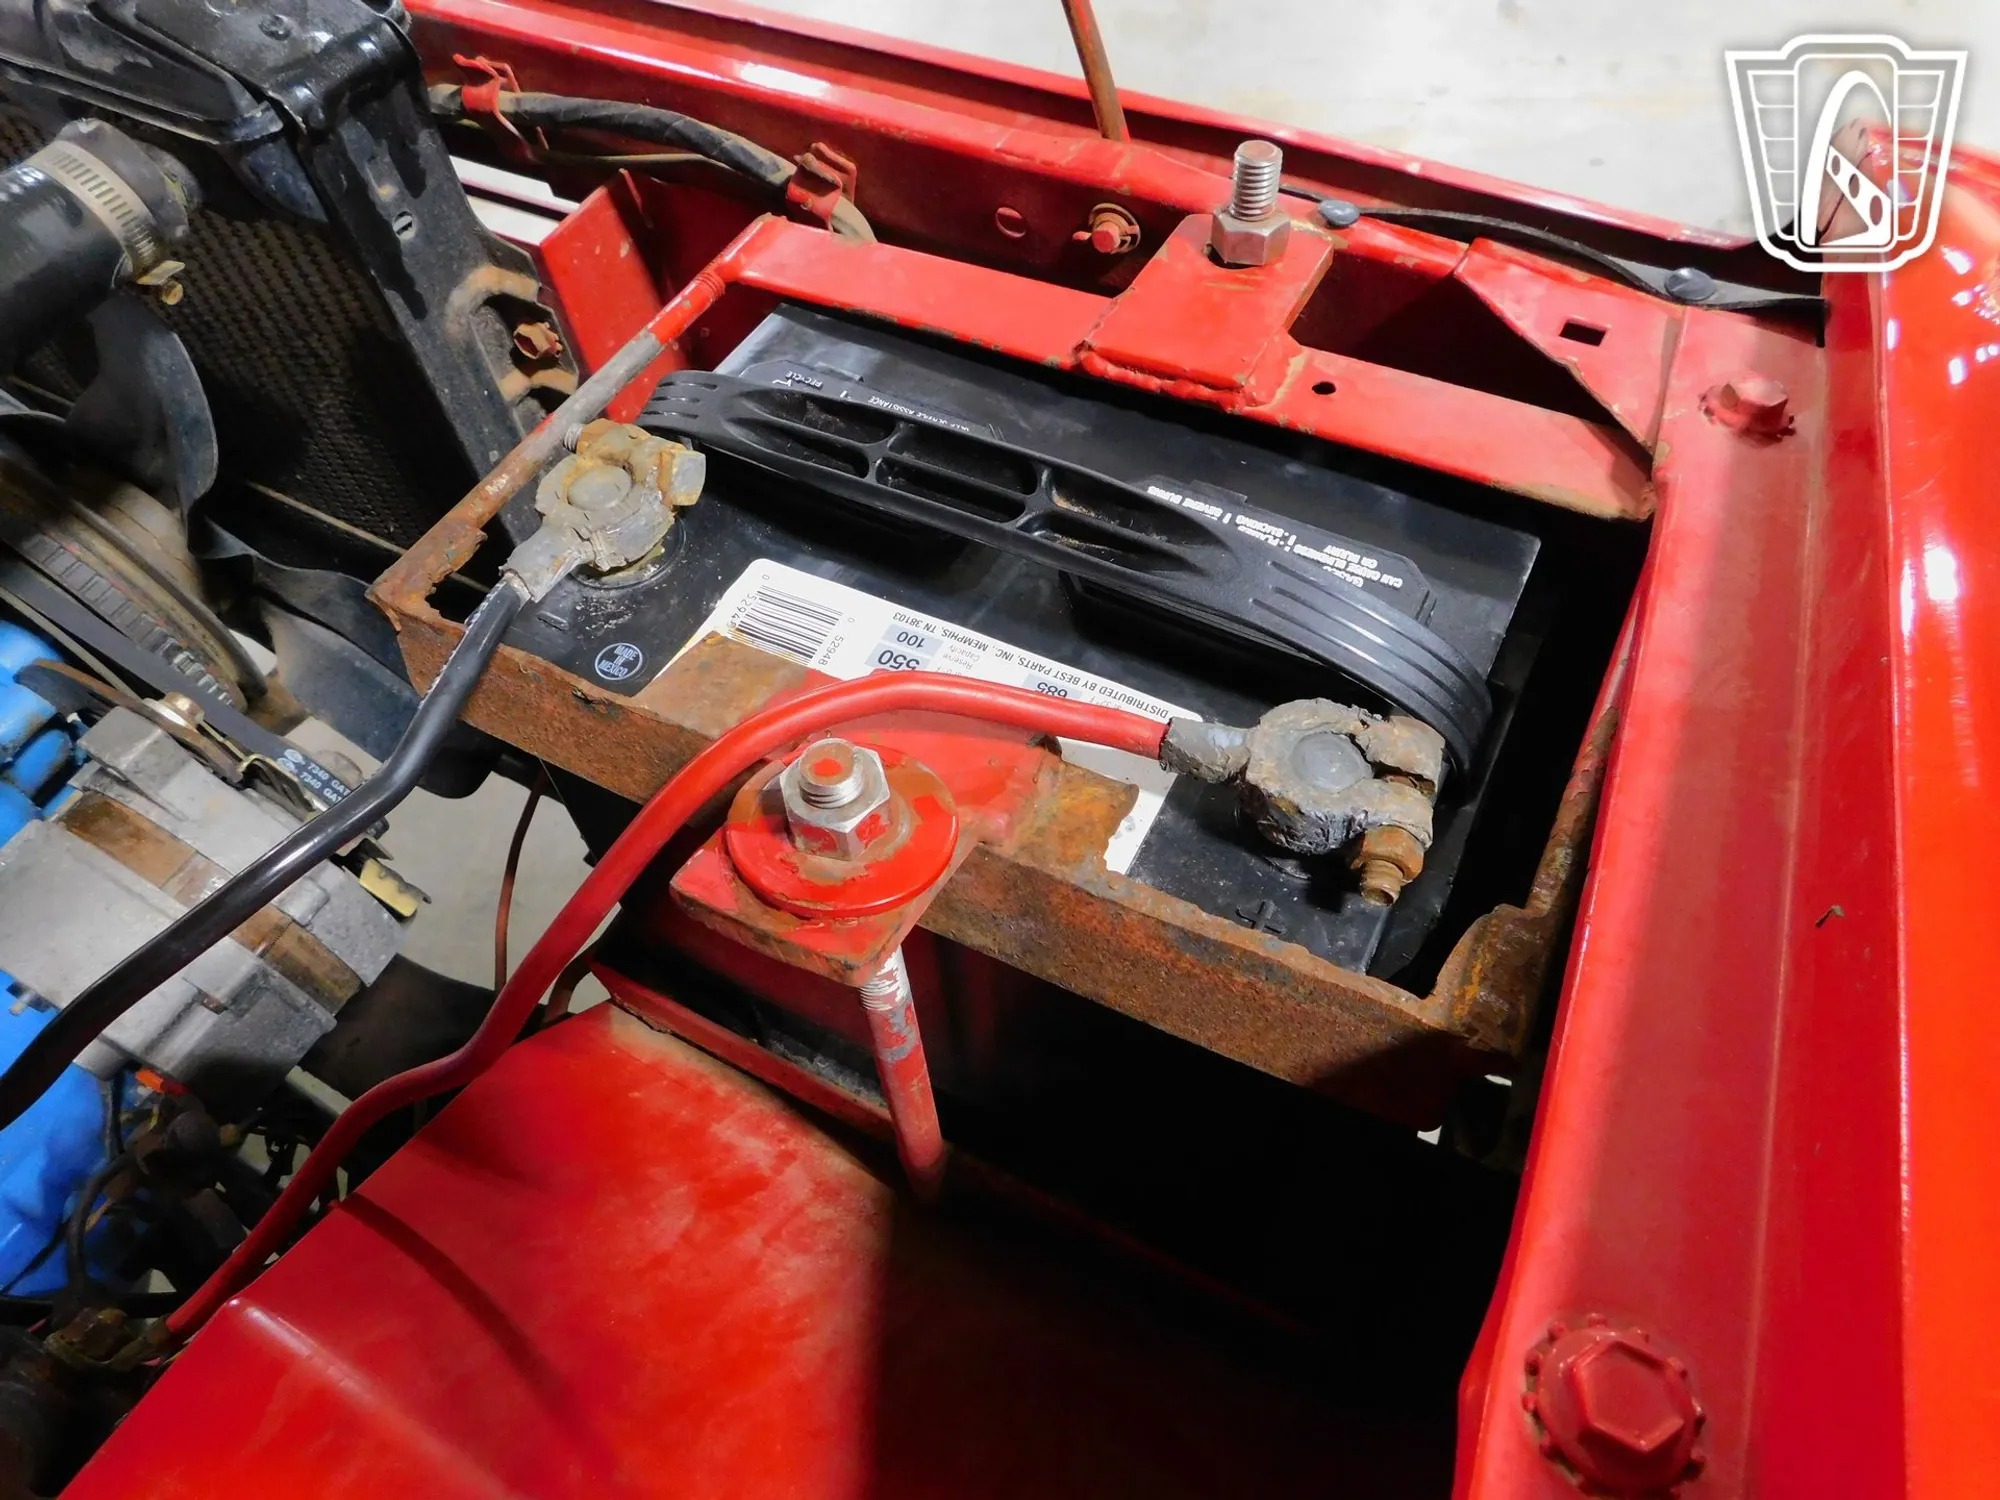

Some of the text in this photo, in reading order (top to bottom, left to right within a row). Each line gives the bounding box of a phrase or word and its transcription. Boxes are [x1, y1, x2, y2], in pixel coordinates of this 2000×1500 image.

[786, 371, 823, 388] RECYCLE
[1147, 486, 1182, 505] BURNS
[1323, 545, 1378, 569] OR INJURY
[1346, 562, 1381, 581] CAUSE
[1380, 574, 1403, 588] CAN
[896, 631, 925, 648] 100
[613, 645, 638, 661] MADE
[818, 635, 844, 666] 52948
[949, 645, 981, 663] Capacity
[598, 659, 629, 677] MEXICO
[613, 655, 626, 666] IN
[878, 649, 920, 671] 550
[893, 611, 1169, 719] DISTRIBUTED BY BEST PARTS, INC., MEMPHIS, TN 38103
[943, 653, 974, 670] Reserve
[1037, 681, 1068, 699] 685
[300, 771, 322, 789] 7340
[307, 762, 330, 780] 7340
